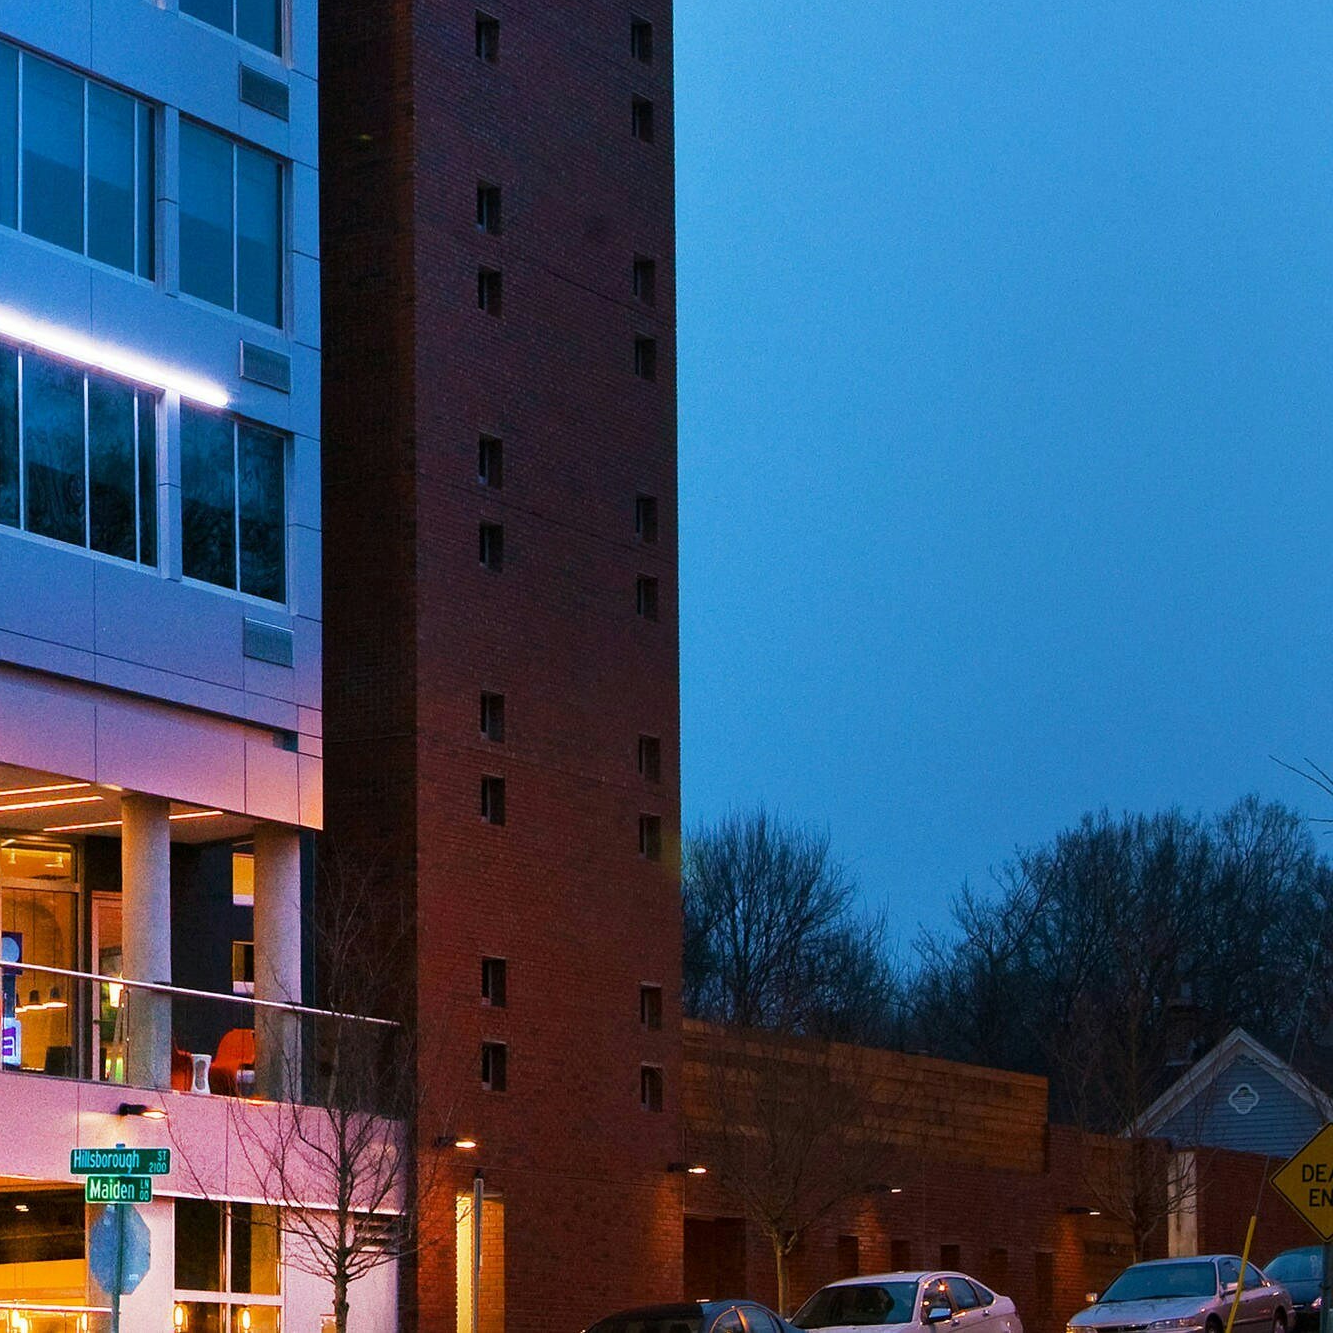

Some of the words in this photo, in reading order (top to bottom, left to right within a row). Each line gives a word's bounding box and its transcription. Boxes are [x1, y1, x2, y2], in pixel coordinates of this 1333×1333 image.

[74, 1149, 140, 1175] Hillsborough
[157, 1150, 167, 1162] ST
[149, 1162, 167, 1173] 2100
[89, 1178, 135, 1199] Maiden
[140, 1179, 150, 1189] LN
